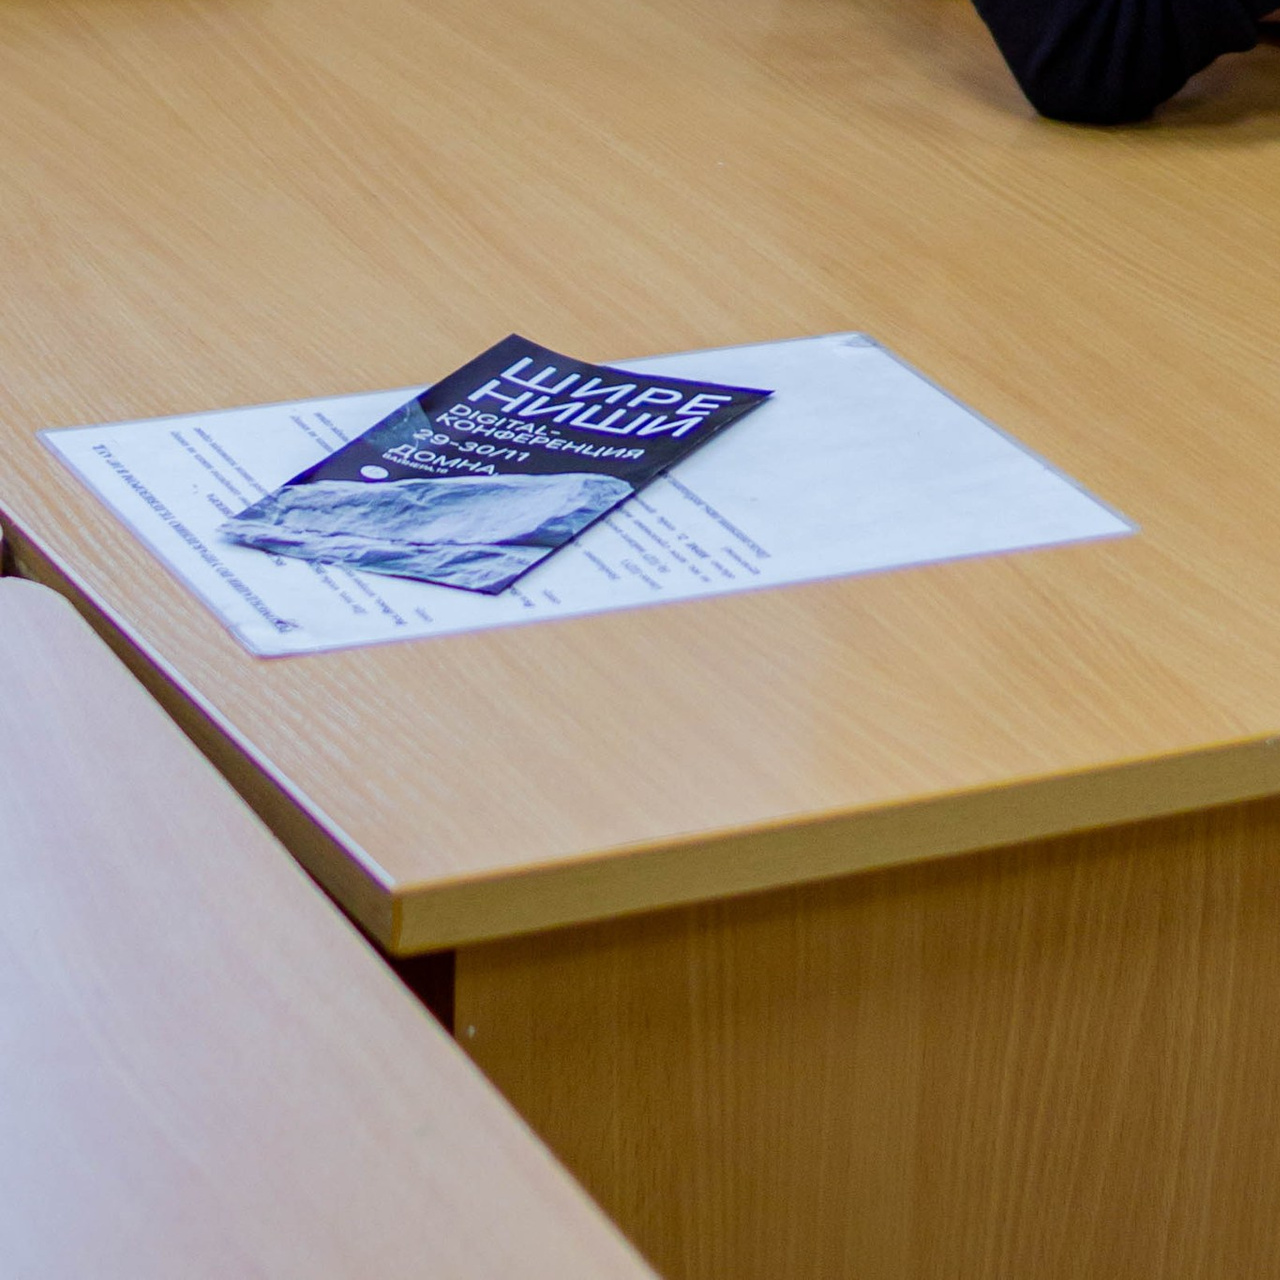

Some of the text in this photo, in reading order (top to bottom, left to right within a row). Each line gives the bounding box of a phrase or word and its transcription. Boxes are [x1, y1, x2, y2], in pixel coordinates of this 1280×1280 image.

[467, 378, 703, 438] НИШИ
[500, 356, 732, 416] ШИРЕ
[436, 412, 645, 460] КОНФЕРЕНЦИЯ
[449, 403, 561, 436] DIGITAL-
[412, 428, 530, 463] 29-30/11
